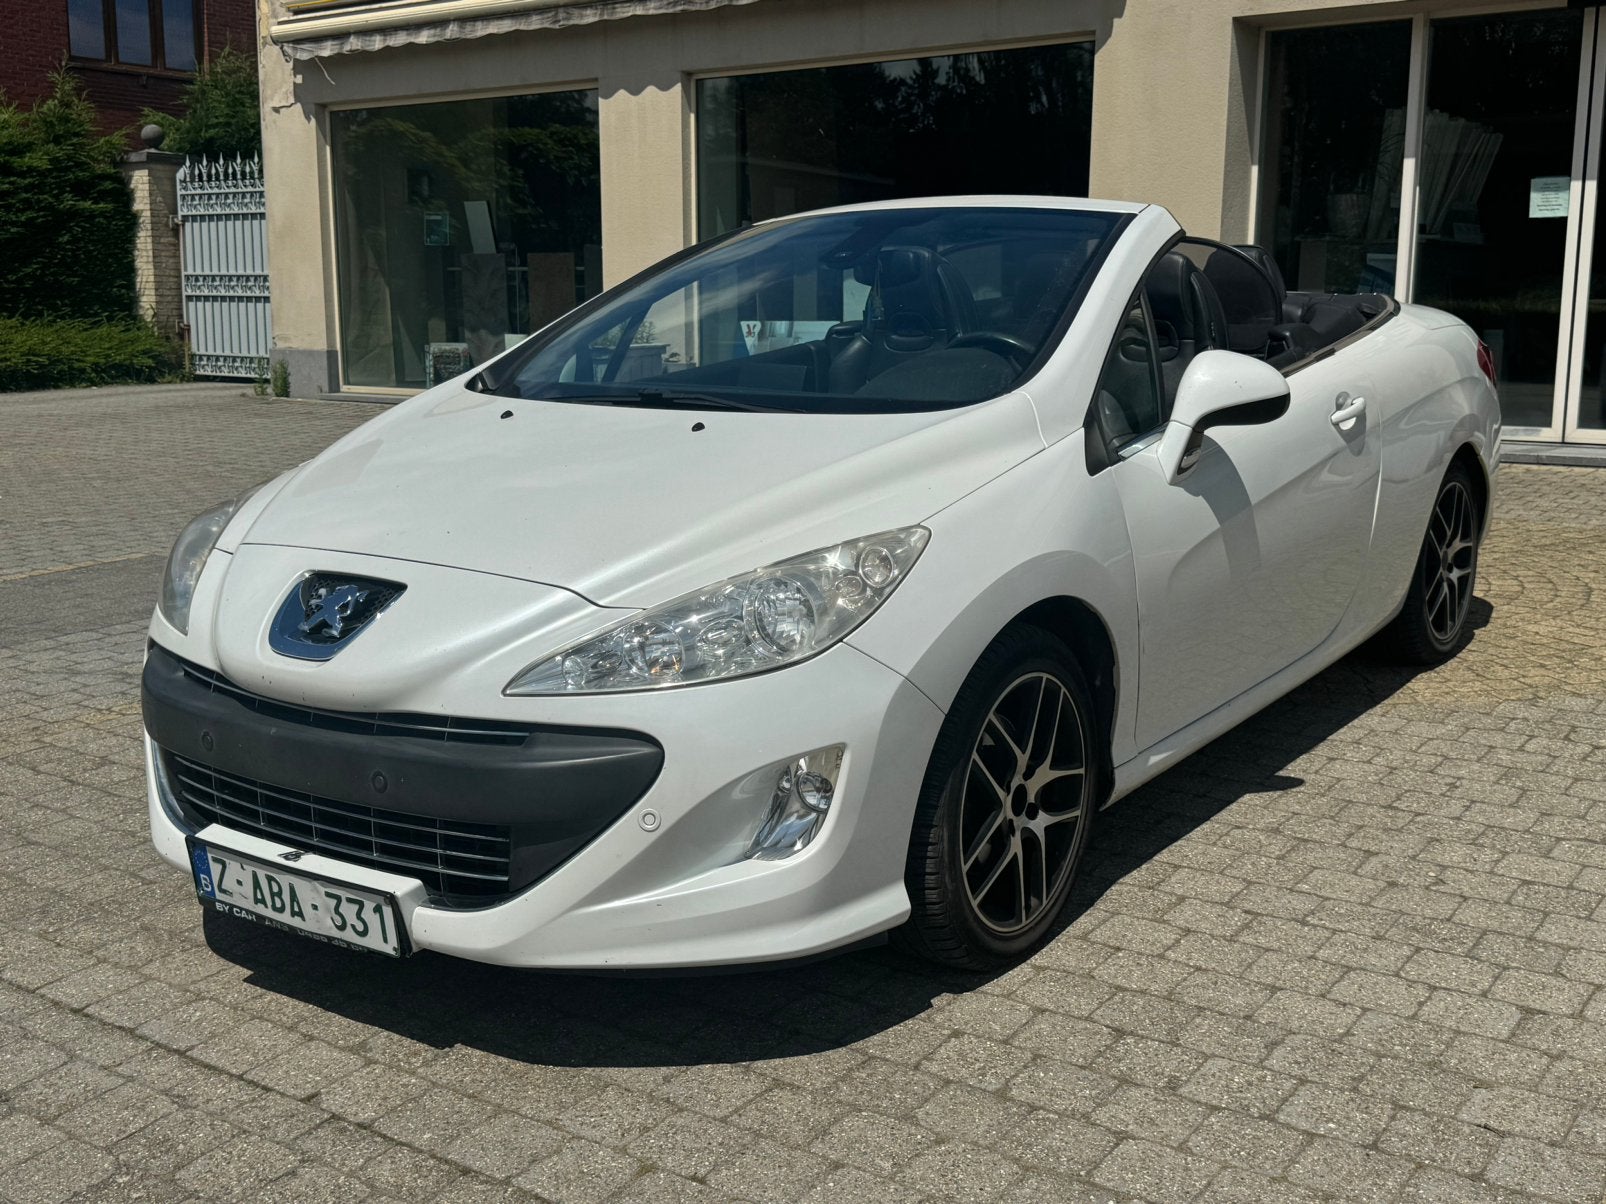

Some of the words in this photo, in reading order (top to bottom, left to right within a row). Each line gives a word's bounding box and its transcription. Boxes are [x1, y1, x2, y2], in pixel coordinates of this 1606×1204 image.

[200, 873, 211, 891] B
[211, 855, 389, 944] Z-ABA-331
[215, 901, 230, 914] BY
